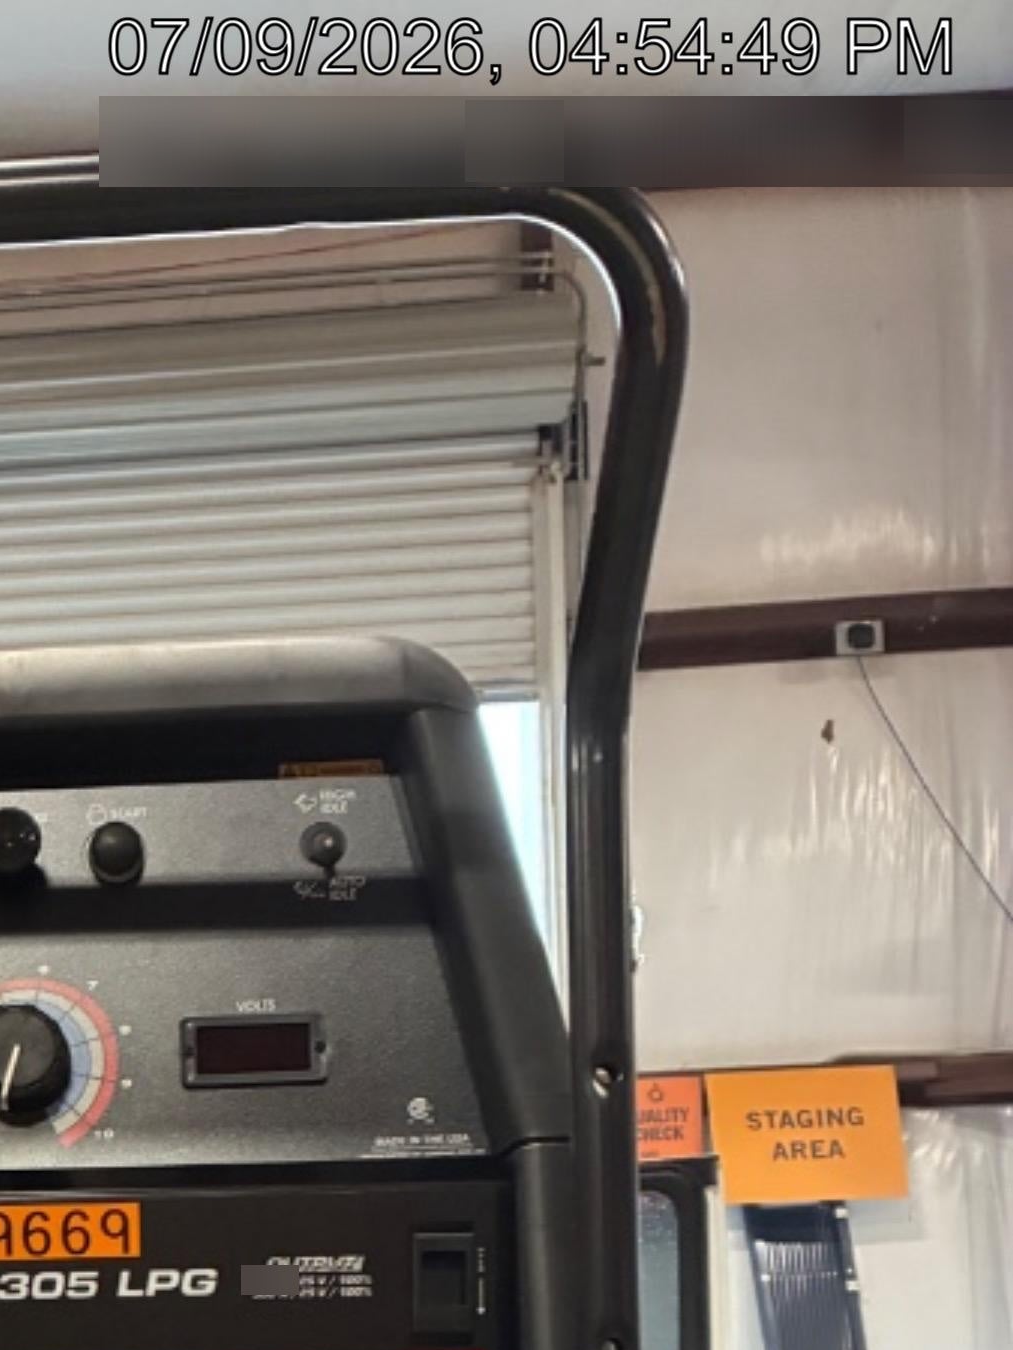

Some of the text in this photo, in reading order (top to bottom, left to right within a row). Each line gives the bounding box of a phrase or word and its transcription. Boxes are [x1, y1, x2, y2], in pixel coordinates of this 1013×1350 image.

[744, 1105, 865, 1132] STAGING
[772, 1138, 846, 1161] AREA
[116, 1267, 220, 1298] LPG
